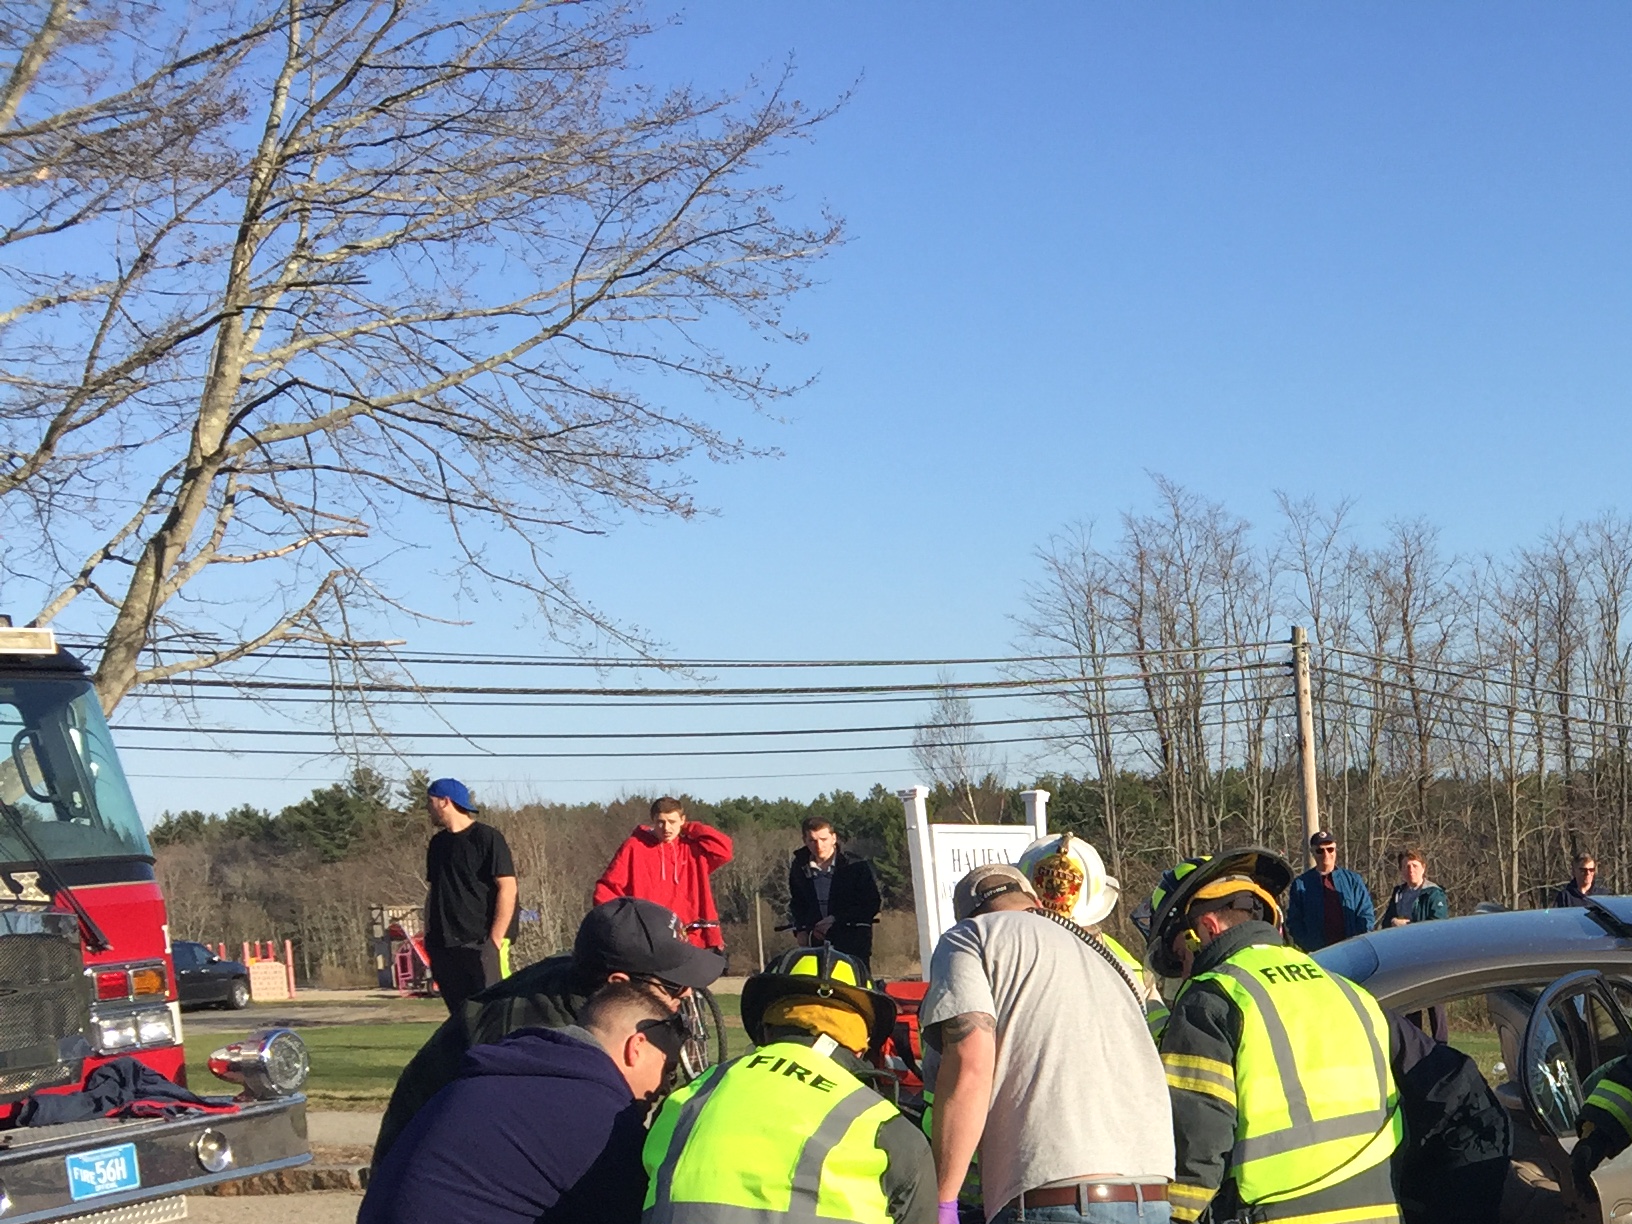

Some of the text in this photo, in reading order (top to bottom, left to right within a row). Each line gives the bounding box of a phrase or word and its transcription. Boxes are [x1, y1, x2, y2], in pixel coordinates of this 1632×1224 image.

[1259, 963, 1324, 984] FIRE
[746, 1055, 838, 1093] FIRE
[72, 1156, 128, 1186] FIRE 56H
